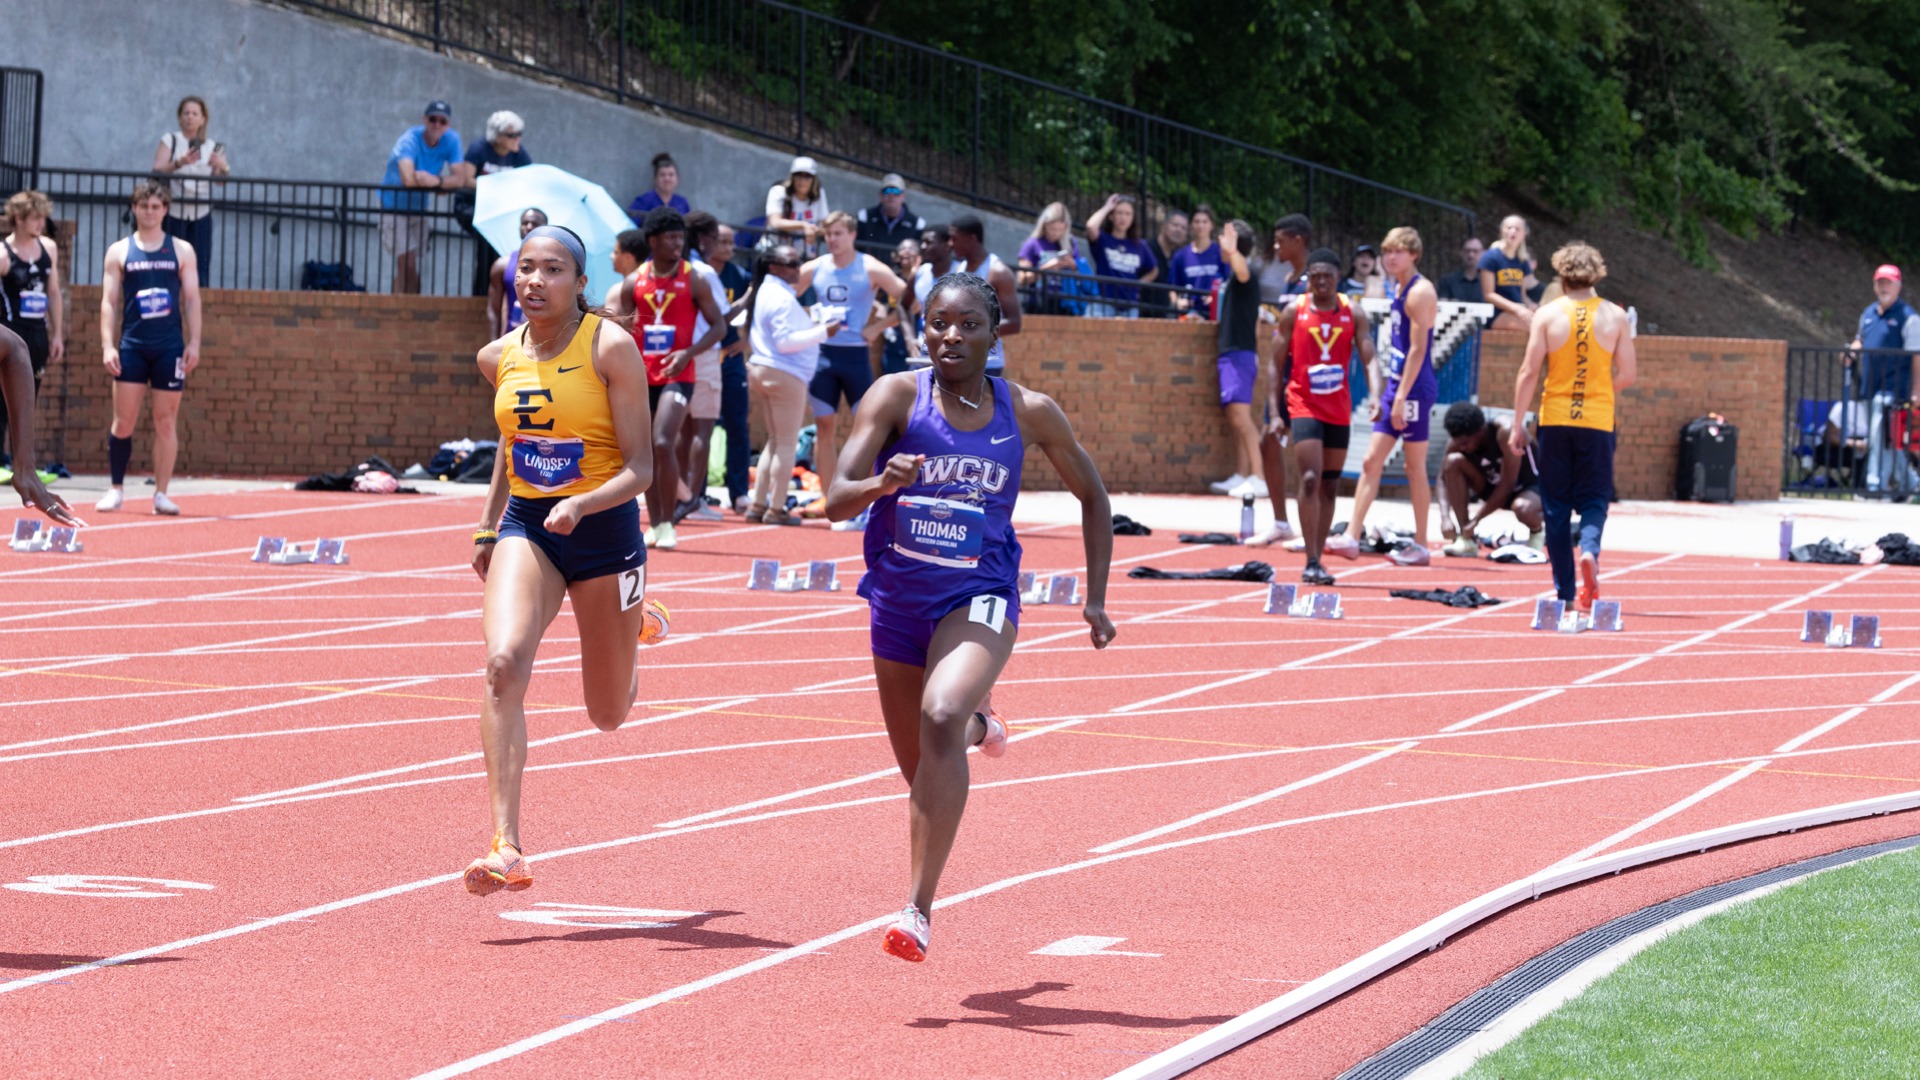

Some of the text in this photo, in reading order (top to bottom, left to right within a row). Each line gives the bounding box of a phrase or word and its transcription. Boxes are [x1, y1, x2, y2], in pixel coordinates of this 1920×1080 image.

[1570, 307, 1589, 421] BUCCANEERS
[513, 388, 555, 431] E
[1405, 401, 1415, 420] 3
[524, 453, 571, 472] LINDSEY
[921, 454, 1009, 494] WCU
[910, 518, 968, 542] THOMAS
[915, 536, 958, 548] WESTERN CAROLINA
[625, 569, 640, 607] 2
[981, 596, 998, 625] 1
